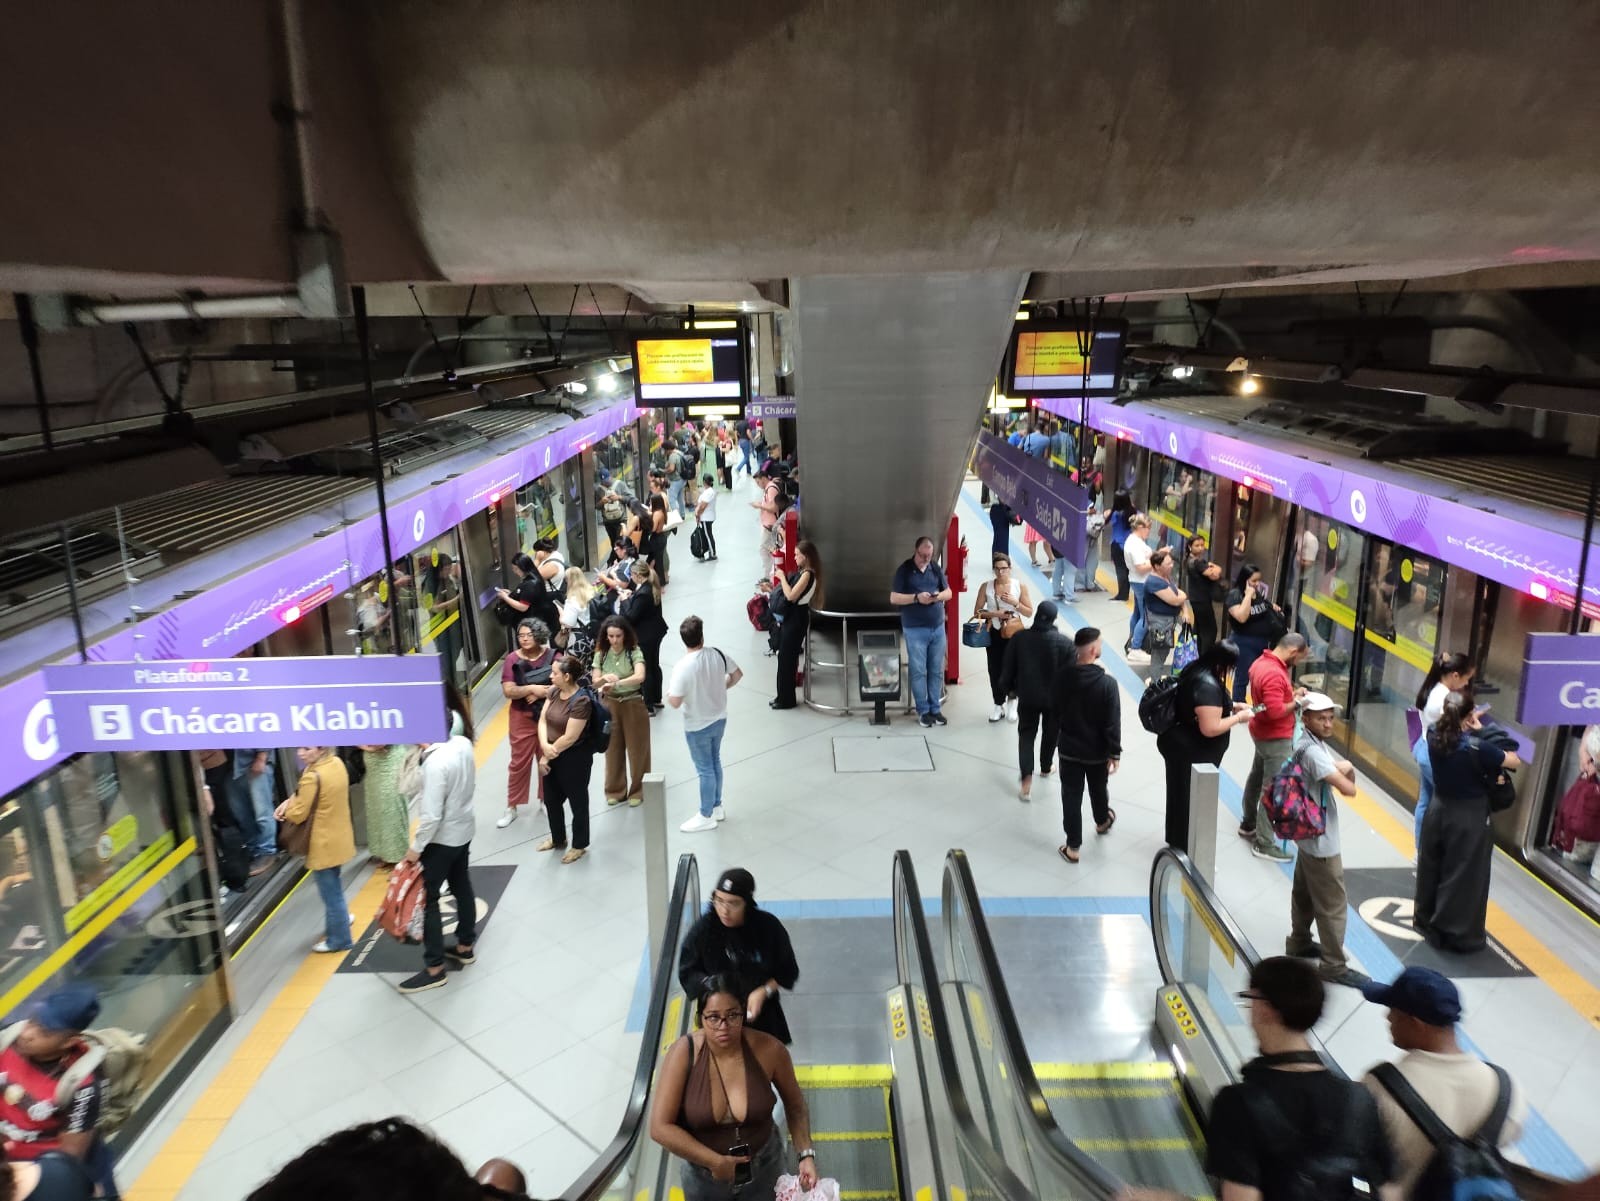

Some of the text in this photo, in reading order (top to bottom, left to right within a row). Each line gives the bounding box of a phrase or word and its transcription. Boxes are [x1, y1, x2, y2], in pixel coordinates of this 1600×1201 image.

[1036, 498, 1052, 529] Saída
[134, 667, 250, 684] Plataforma 2
[140, 706, 280, 735] Chácara
[290, 701, 404, 732] Klabin
